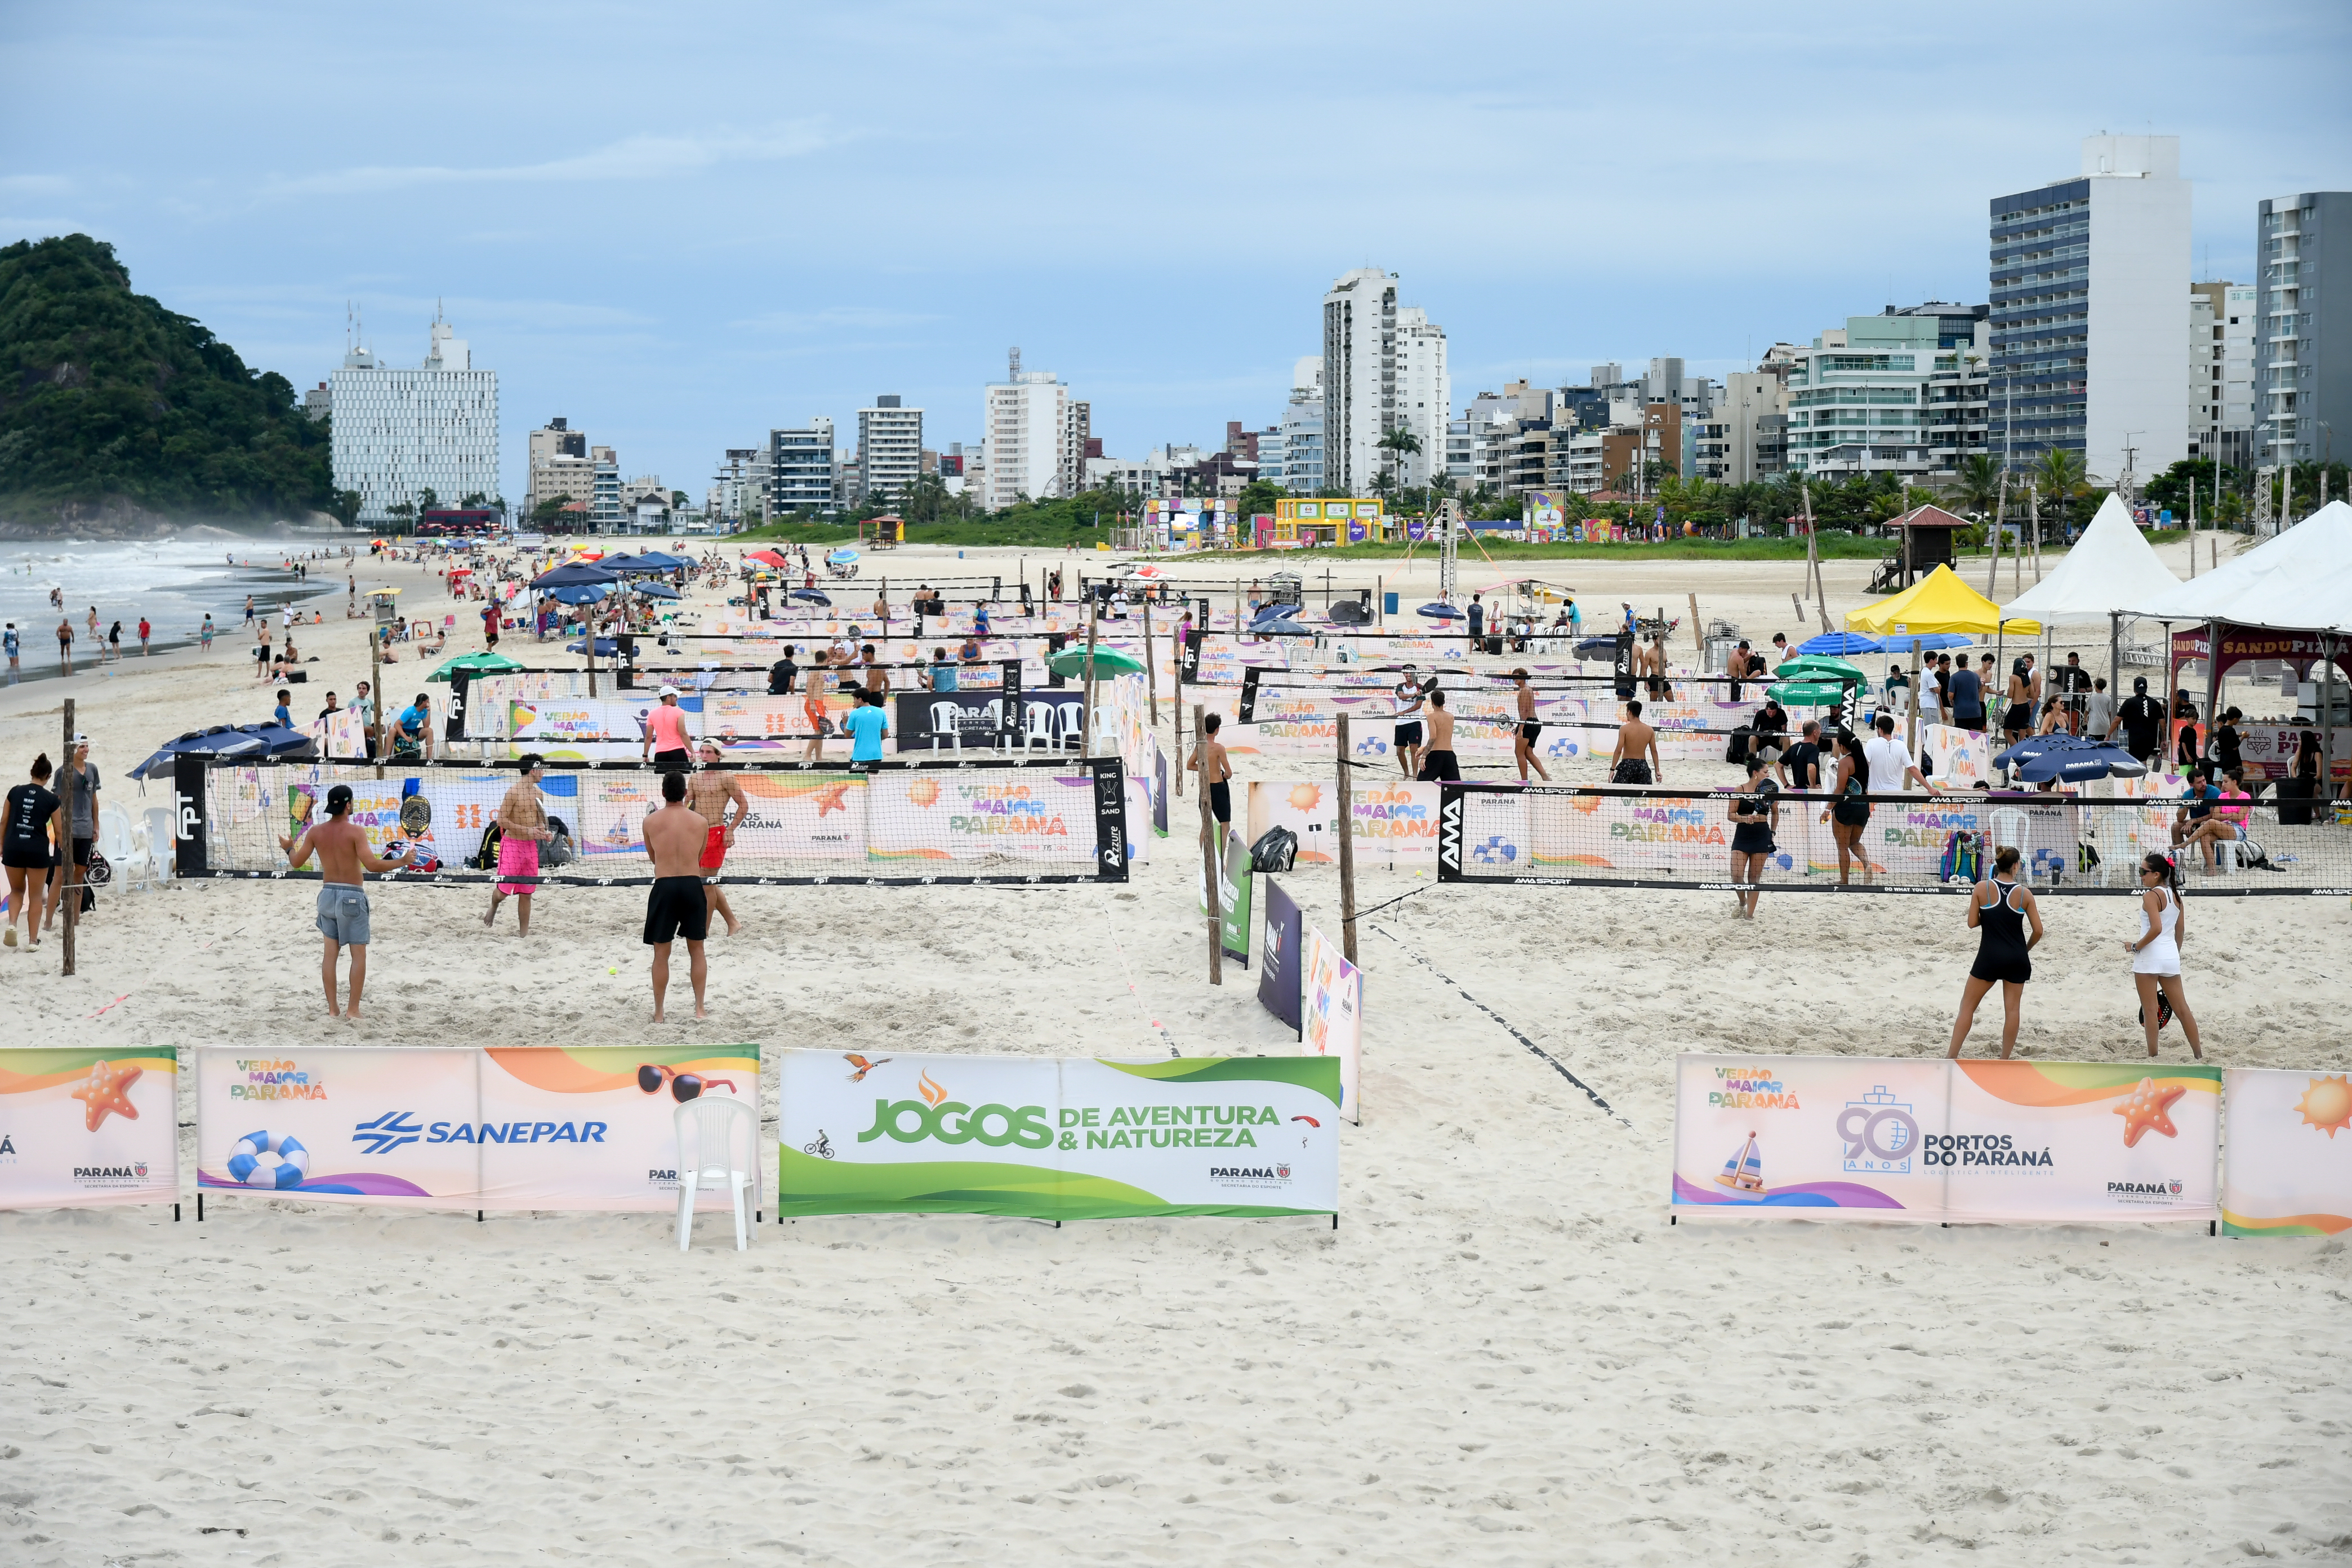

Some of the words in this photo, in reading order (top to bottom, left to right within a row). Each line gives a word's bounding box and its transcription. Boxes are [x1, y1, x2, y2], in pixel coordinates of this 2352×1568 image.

[1184, 647, 1196, 669] FPT
[448, 688, 464, 719] FPT
[1650, 706, 1698, 718] VERÃO
[554, 722, 599, 731] MAIOR
[1659, 719, 1708, 728] MAIOR
[958, 782, 1031, 799] VERÃO
[1351, 782, 1412, 804] ERÃO
[176, 791, 201, 840] FPT
[973, 800, 1045, 815] MAIOR
[1353, 804, 1427, 819] MAIOR
[348, 811, 399, 826] MAIO
[950, 813, 1067, 836] PARANÁ
[1634, 808, 1705, 825] MAIOR
[1907, 813, 1977, 828] MAIOR
[1441, 798, 1461, 871] AMA
[1611, 822, 1726, 845] PARANÁ
[237, 1057, 296, 1071] VERÃO
[249, 1072, 308, 1084] MAIOR
[1715, 1066, 1772, 1080] VERÃO
[231, 1081, 328, 1100] PARANÁ
[1726, 1080, 1783, 1093] MAIOR
[1709, 1090, 1800, 1110] PARANÁ
[858, 1099, 1054, 1149] JOGOS
[1059, 1108, 1100, 1128] DE
[1108, 1106, 1280, 1126] AVENTURA
[426, 1121, 607, 1143] SANEPAR
[1058, 1131, 1078, 1150] &
[1086, 1128, 1257, 1149] NATUREZA
[1836, 1107, 1919, 1160] 90
[1924, 1134, 2012, 1150] PORTOS
[1848, 1160, 1907, 1170] ANOS
[1924, 1150, 1957, 1166] DO
[1963, 1147, 2053, 1166] PARANÁ
[74, 1166, 133, 1177] PARANÁ
[1210, 1167, 1275, 1178] PARANÁ
[2108, 1182, 2167, 1193] PARANÁ
